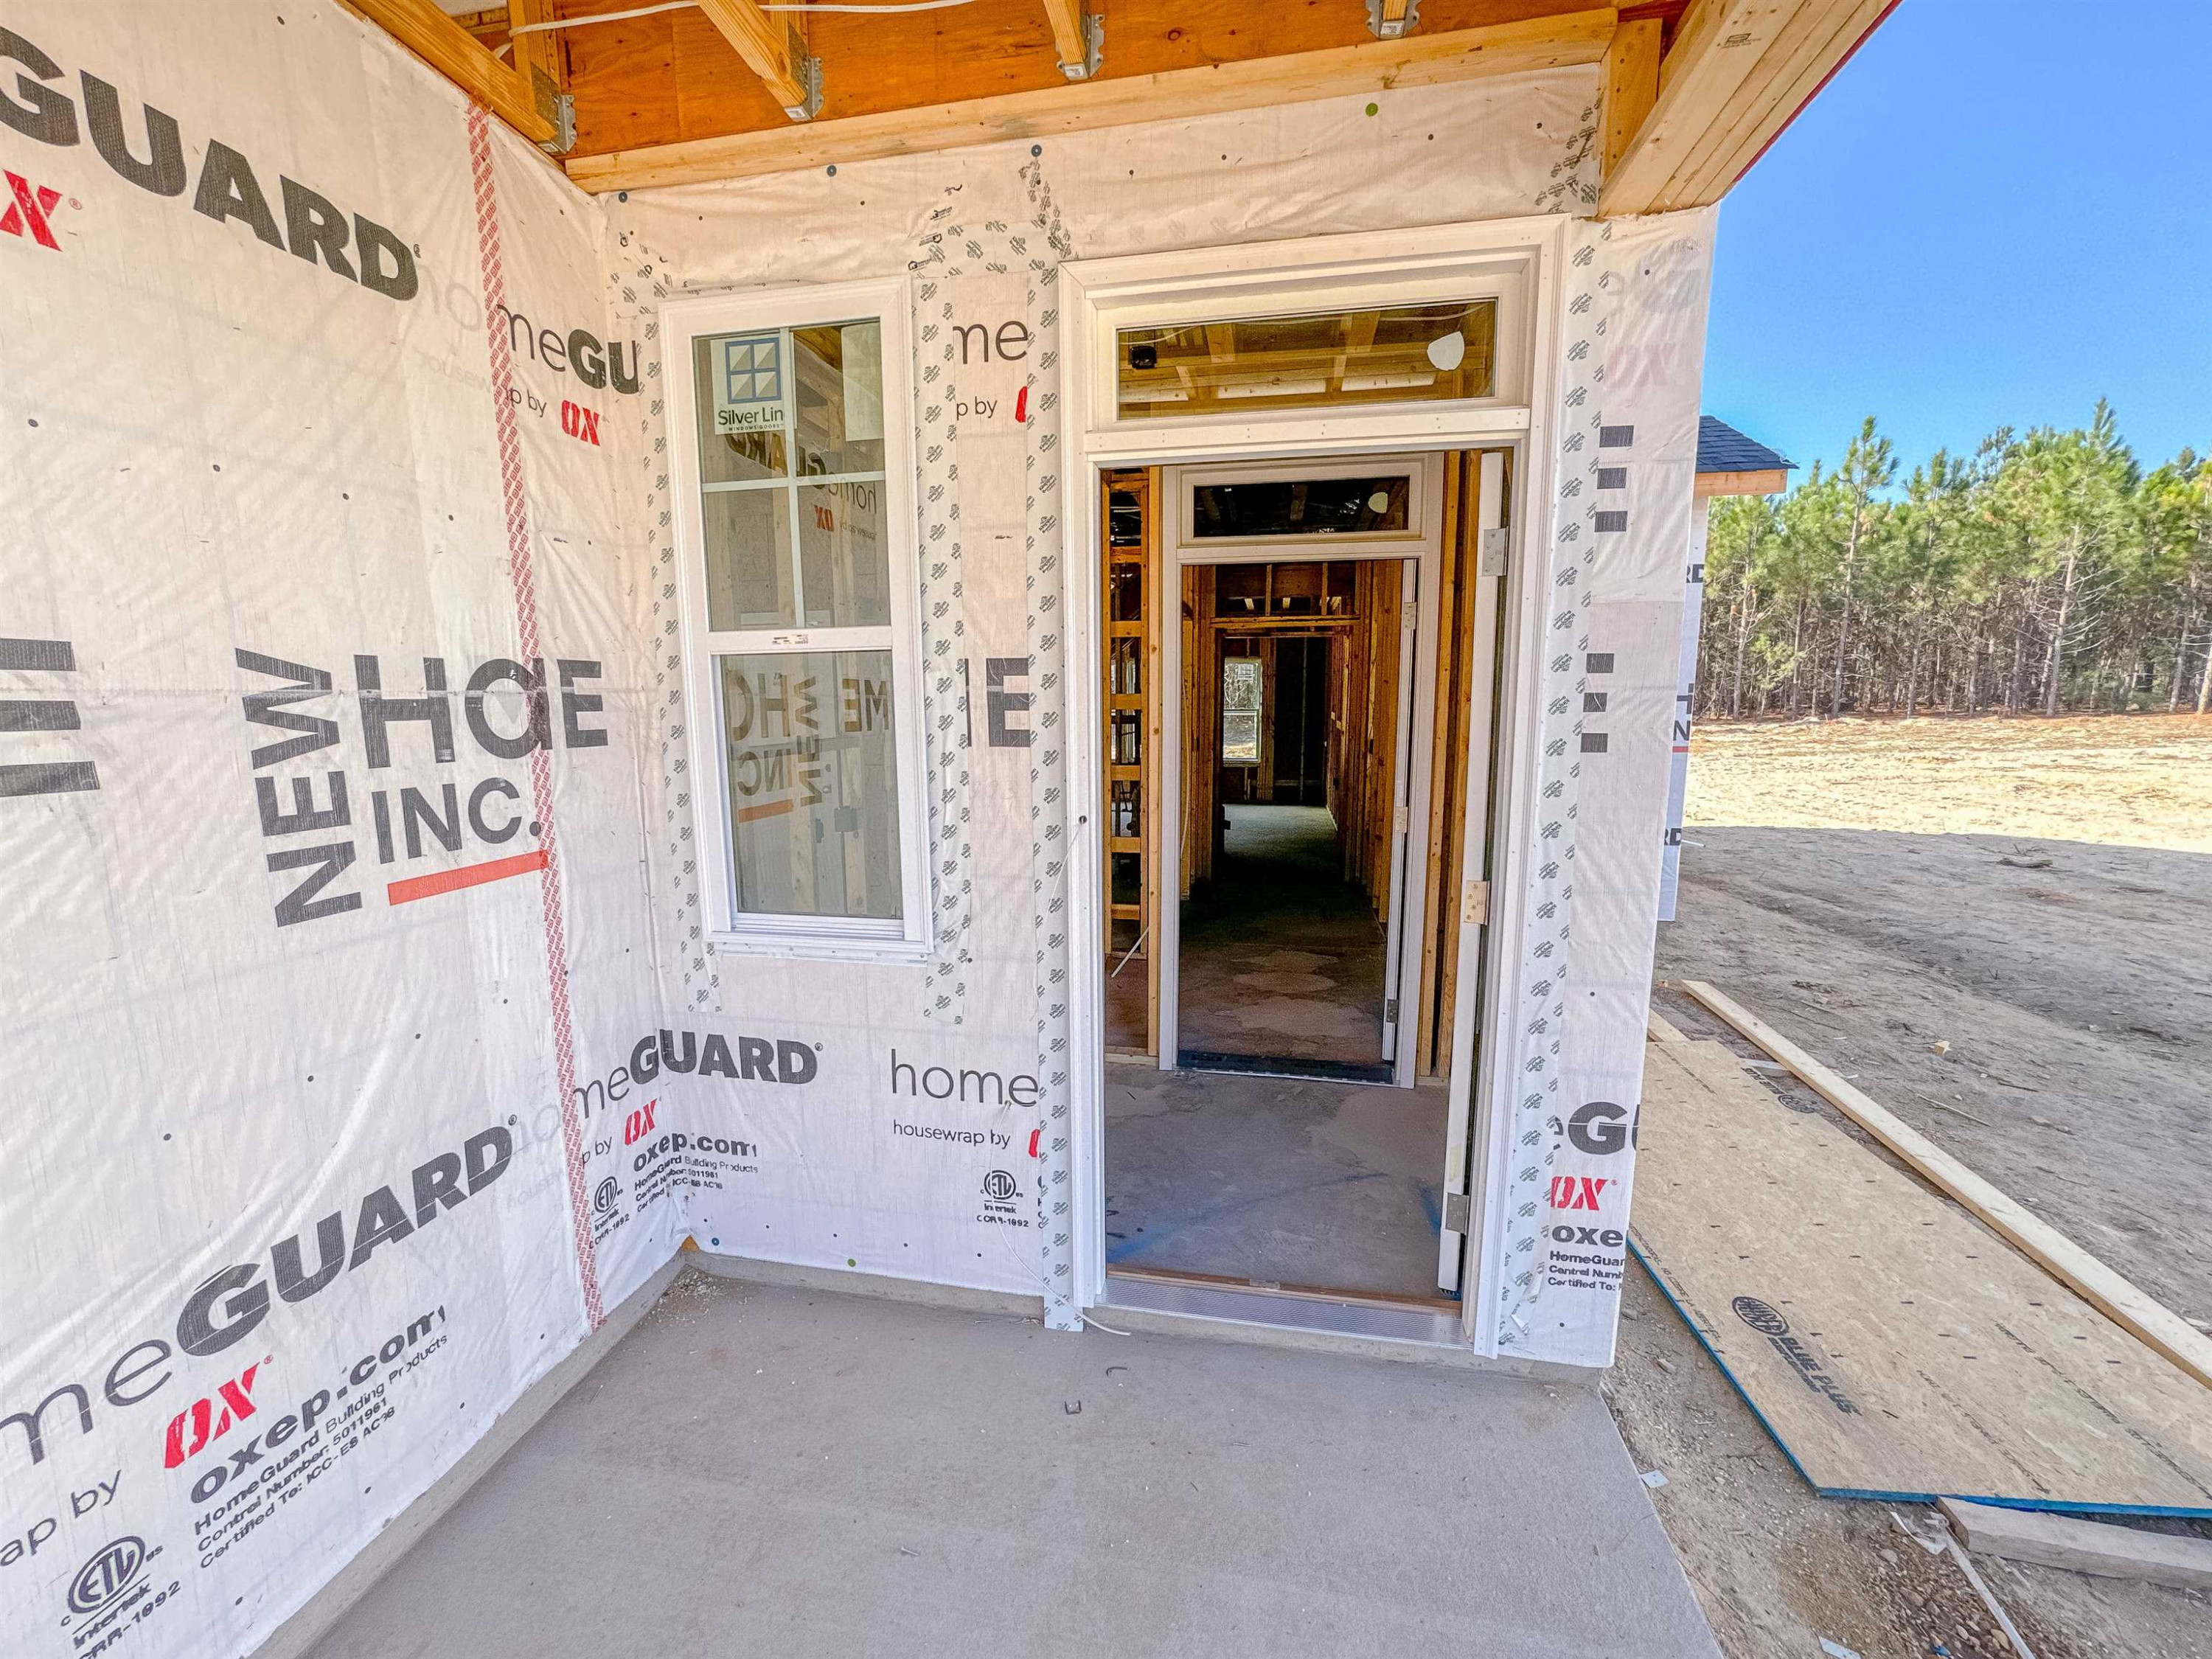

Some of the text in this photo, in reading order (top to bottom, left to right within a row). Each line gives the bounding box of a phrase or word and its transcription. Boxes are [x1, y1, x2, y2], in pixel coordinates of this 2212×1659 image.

[718, 406, 785, 425] Silver Lin
[975, 397, 998, 419] by
[372, 776, 543, 865] INC.
[891, 1048, 1039, 1108] home
[594, 1136, 613, 1157] by
[894, 1119, 984, 1148] housewrap
[991, 1129, 1012, 1151] by
[1552, 1225, 1624, 1248] oxe
[195, 1430, 320, 1536] HomeGuard
[326, 1383, 385, 1433] Building
[71, 1470, 121, 1519] by
[201, 1503, 276, 1570] Certified
